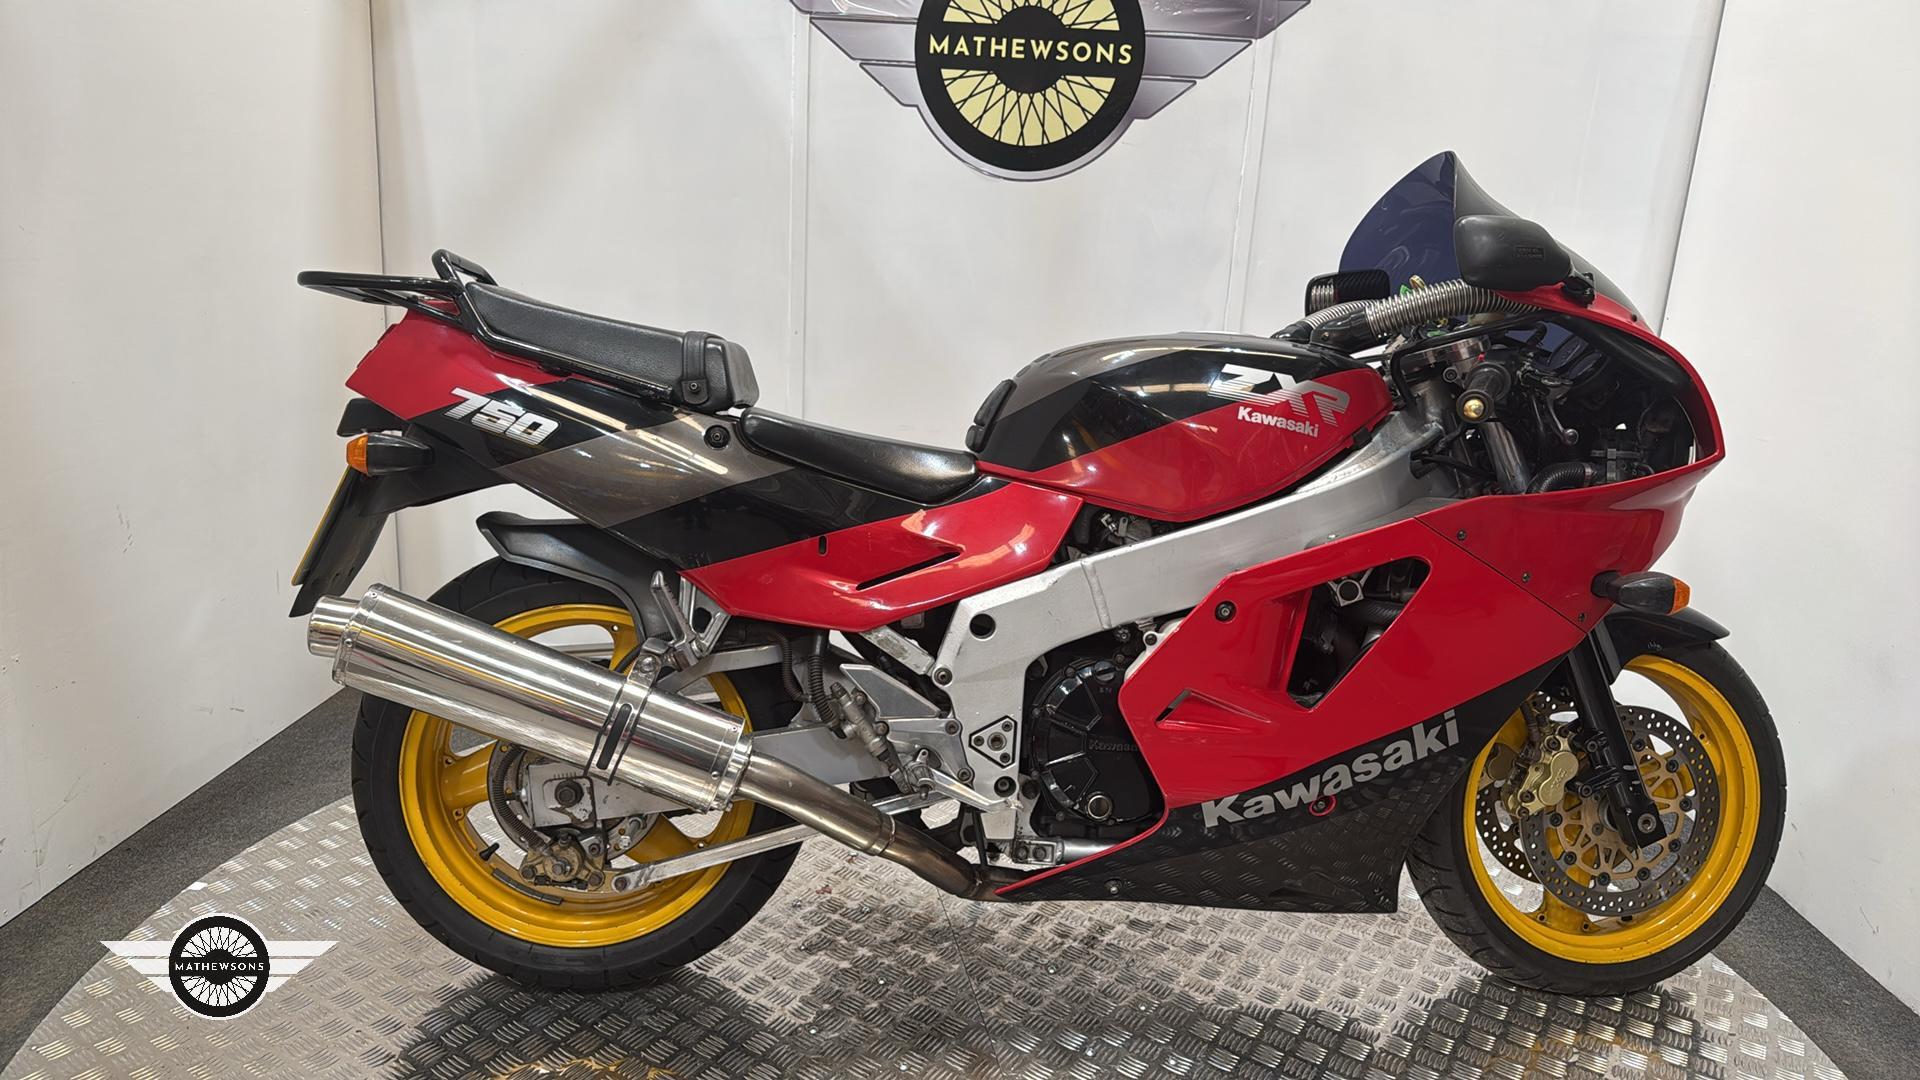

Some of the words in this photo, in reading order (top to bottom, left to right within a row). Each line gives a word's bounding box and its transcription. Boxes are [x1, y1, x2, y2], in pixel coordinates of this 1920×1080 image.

[929, 34, 1133, 65] MATHEWSONS
[444, 387, 559, 446] 750
[1207, 363, 1350, 427] ZXR
[1237, 406, 1319, 438] Kawasaki
[1201, 709, 1459, 828] Kawasaki
